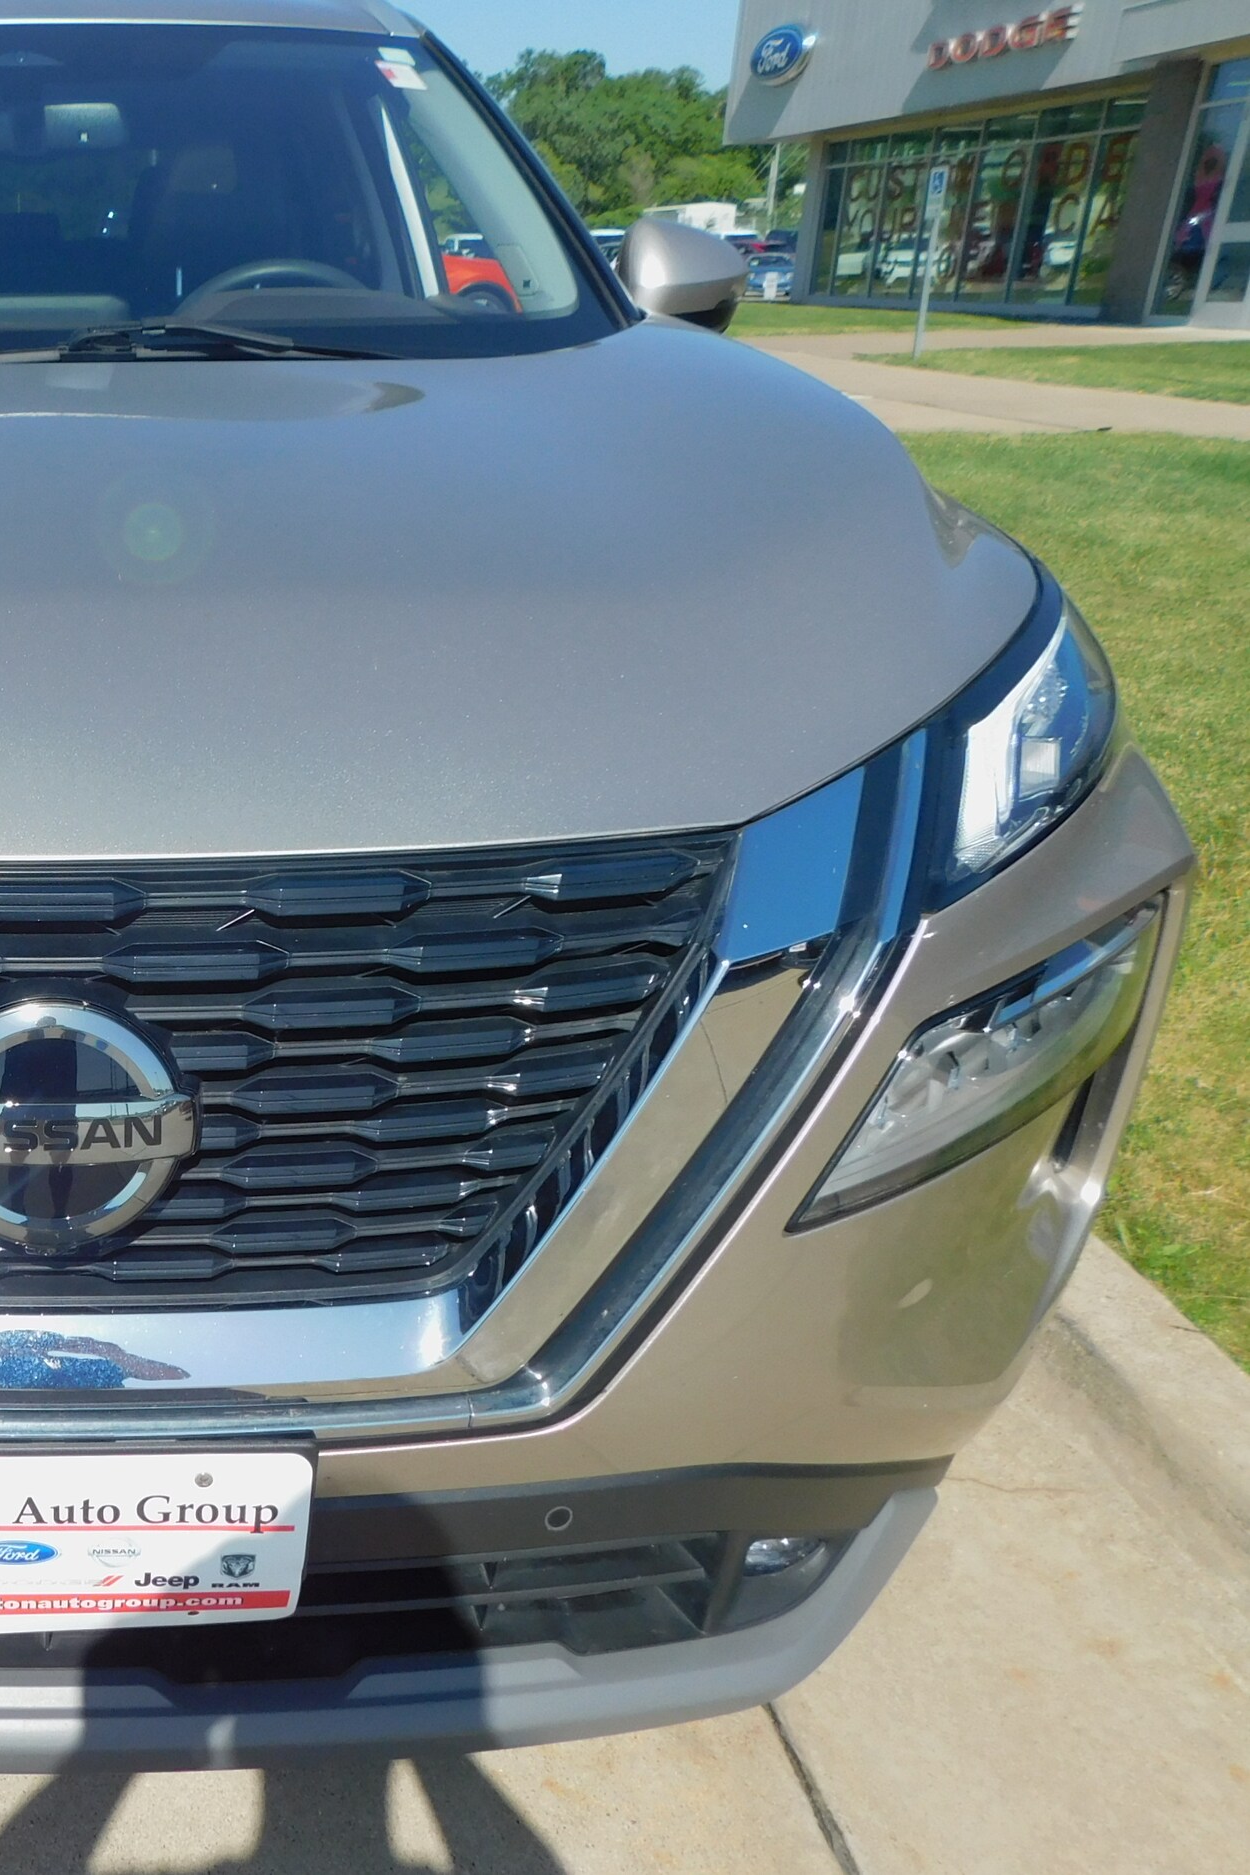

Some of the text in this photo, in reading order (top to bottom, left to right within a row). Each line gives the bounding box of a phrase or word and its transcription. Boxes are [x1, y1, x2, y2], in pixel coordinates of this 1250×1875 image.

[927, 3, 1083, 71] DODGE
[756, 38, 789, 74] Ford
[12, 1496, 120, 1525] Auto
[136, 1495, 279, 1534] Group
[92, 1547, 136, 1555] NISSAN
[134, 1572, 200, 1590] Jeep
